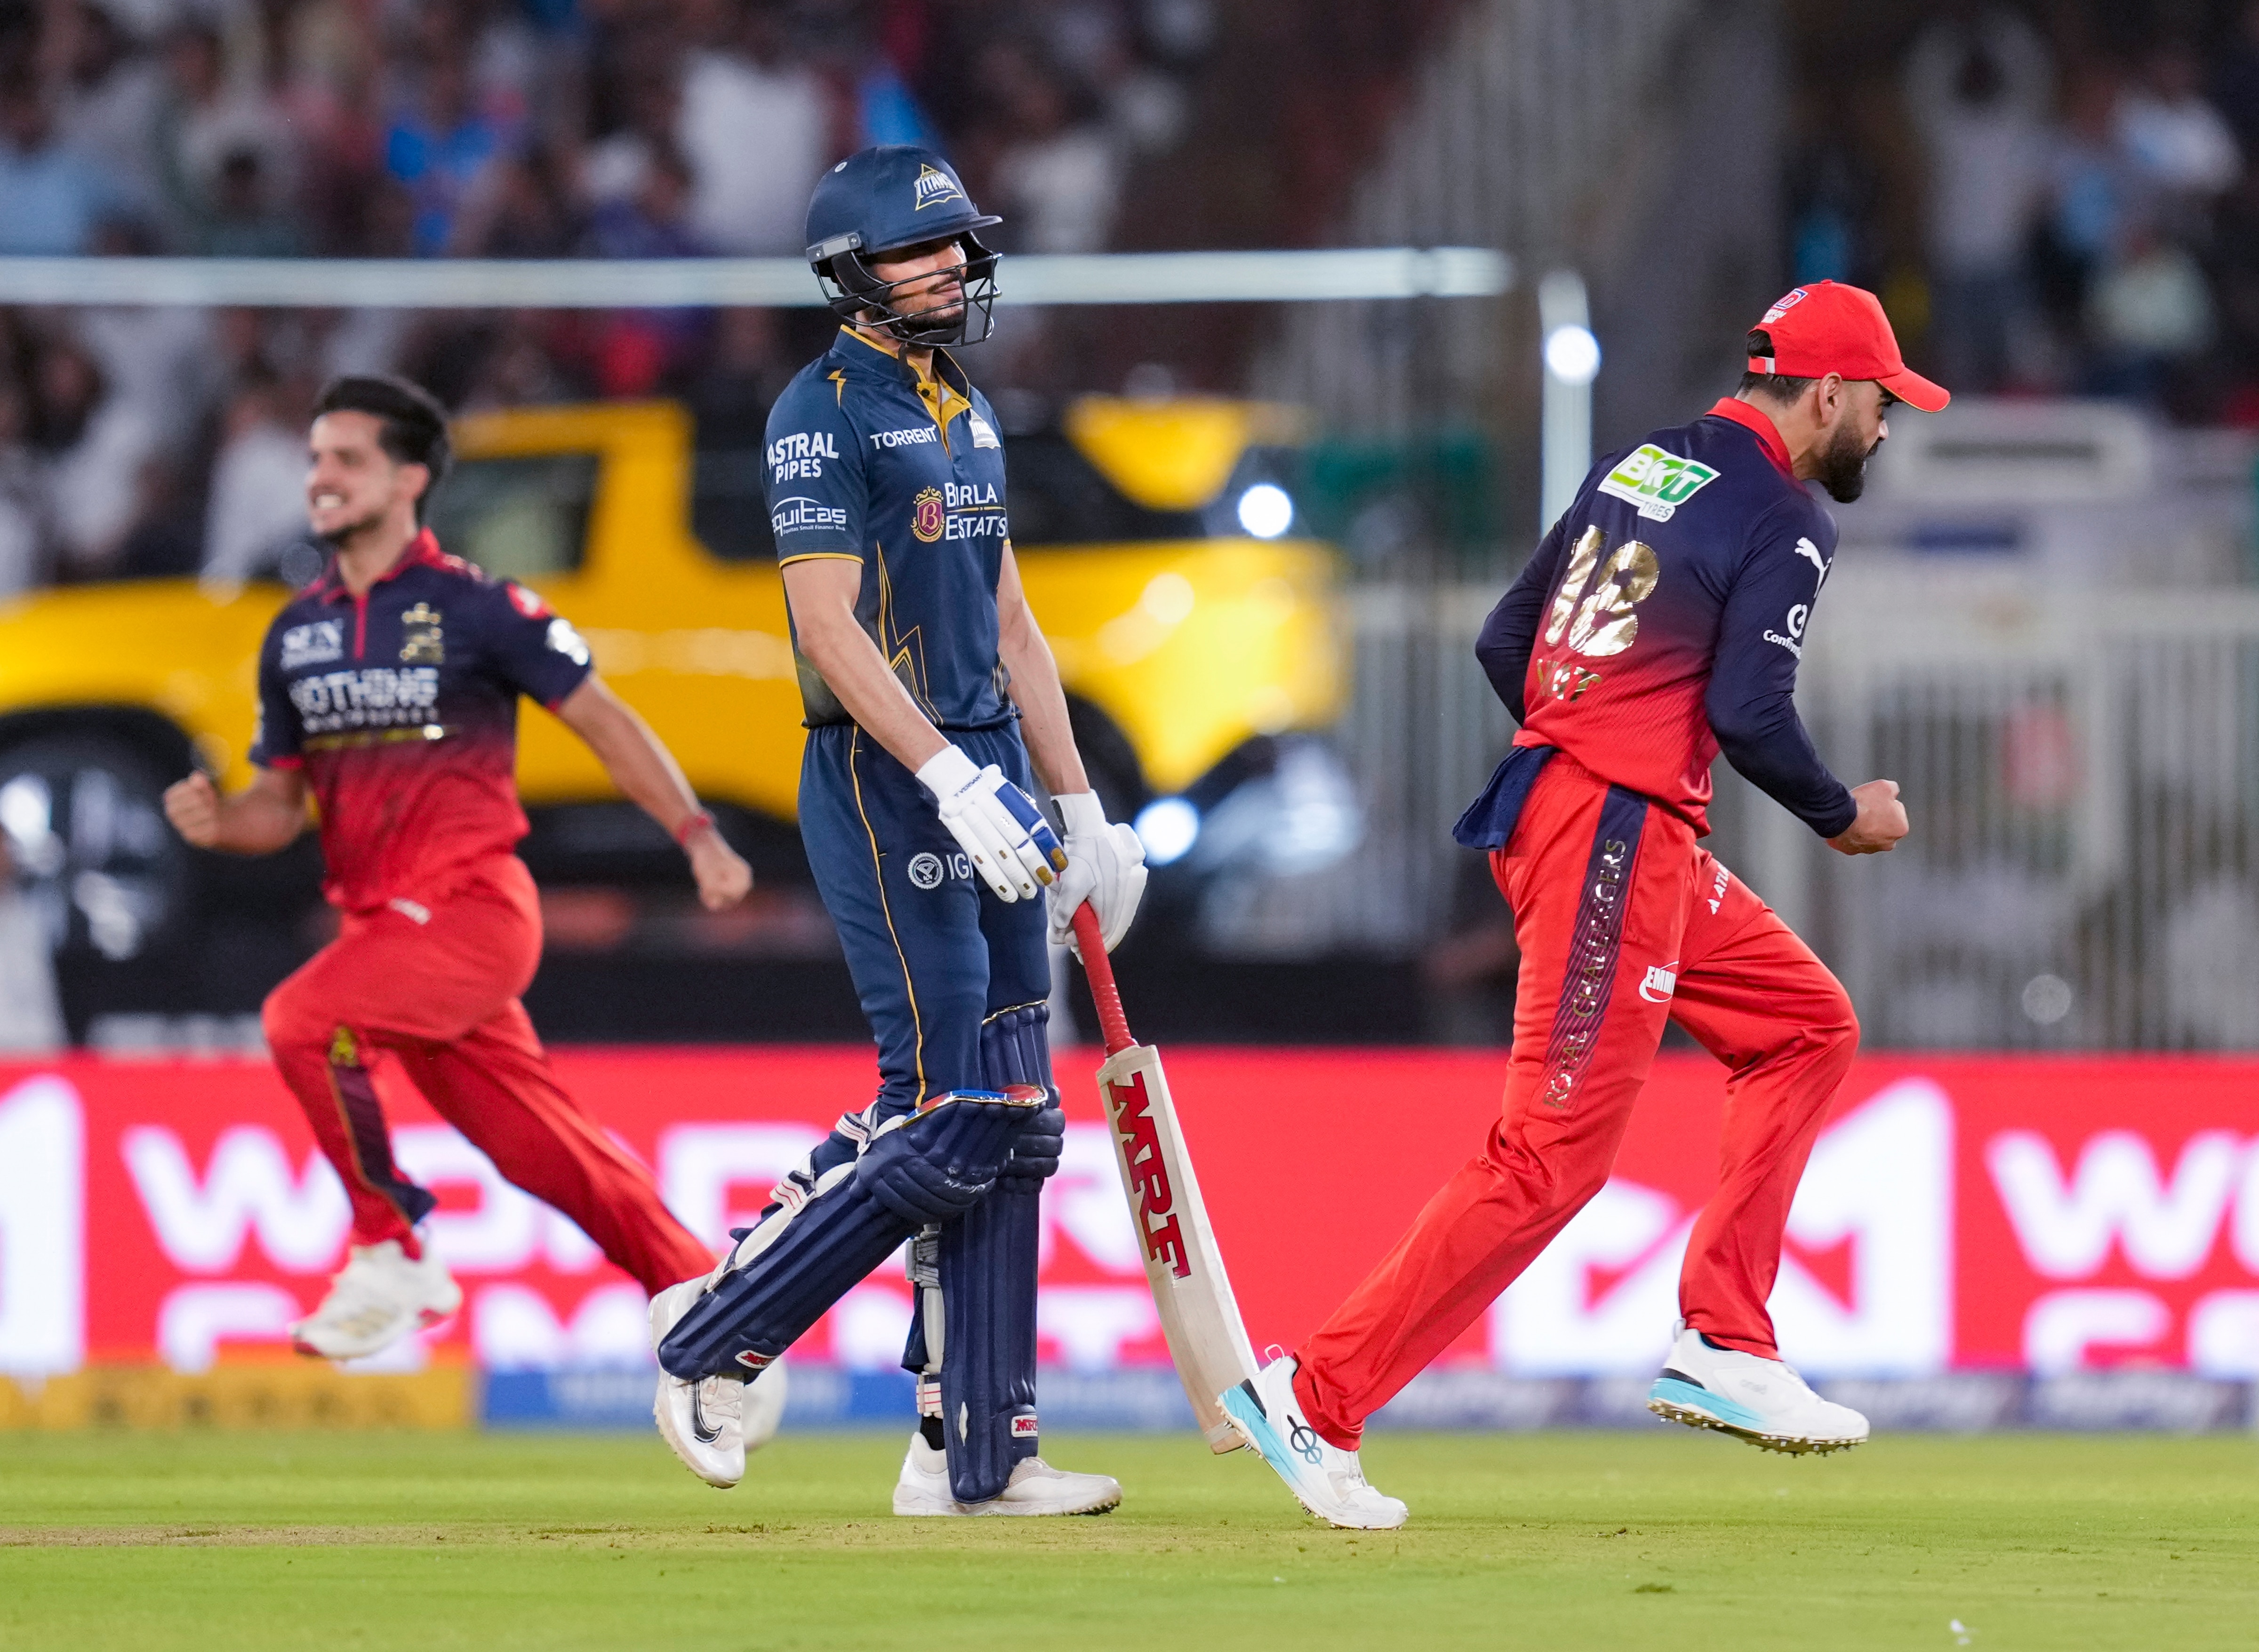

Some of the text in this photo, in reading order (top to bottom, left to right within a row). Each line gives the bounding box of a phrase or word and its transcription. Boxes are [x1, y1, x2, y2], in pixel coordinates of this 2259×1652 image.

[914, 172, 956, 198] TITANS
[870, 425, 937, 450] TORRENT
[767, 432, 839, 470] ASTRAL
[776, 458, 822, 484] PIPES
[1616, 452, 1705, 495] BKT
[945, 482, 998, 507] BIRLA
[1641, 501, 1672, 519] TYRES
[946, 515, 1007, 541] ESTATS
[1545, 524, 1660, 656] 18
[959, 773, 983, 794] VERSANT
[1543, 1030, 1588, 1109] ROYAL
[1107, 1070, 1192, 1280] MRF
